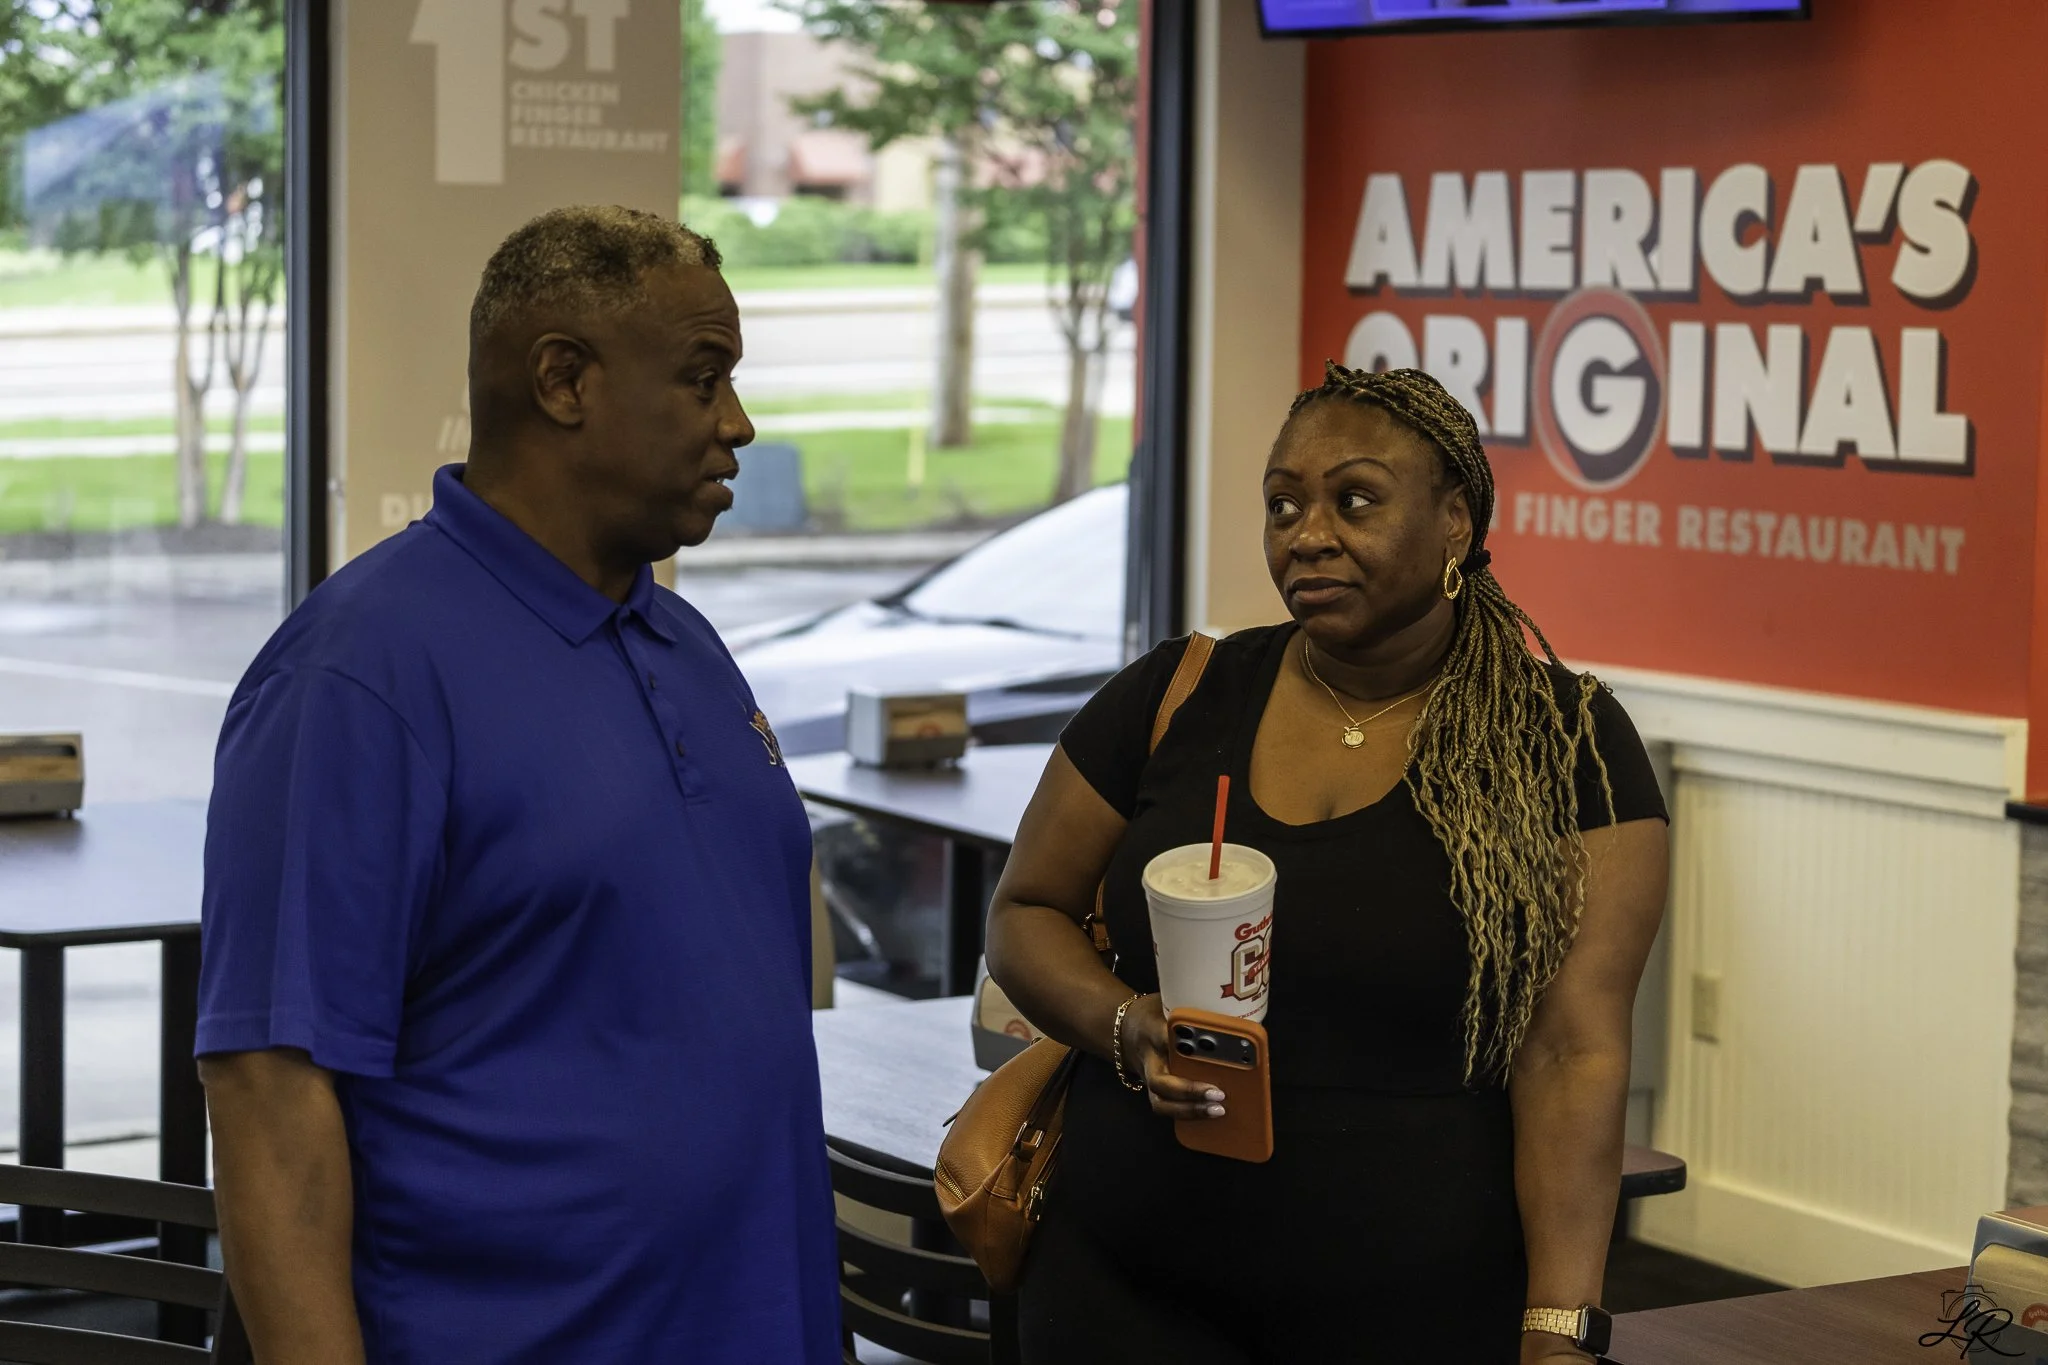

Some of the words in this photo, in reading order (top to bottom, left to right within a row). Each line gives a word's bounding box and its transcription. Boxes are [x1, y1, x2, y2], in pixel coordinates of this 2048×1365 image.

[510, 81, 620, 102] CHICKEN
[510, 104, 602, 125] FINGER
[510, 127, 668, 150] RESTAURANT
[1344, 159, 1975, 302] AMERICA'S
[1513, 492, 1661, 547] FINGER
[1677, 503, 1966, 576] RESTAURANT
